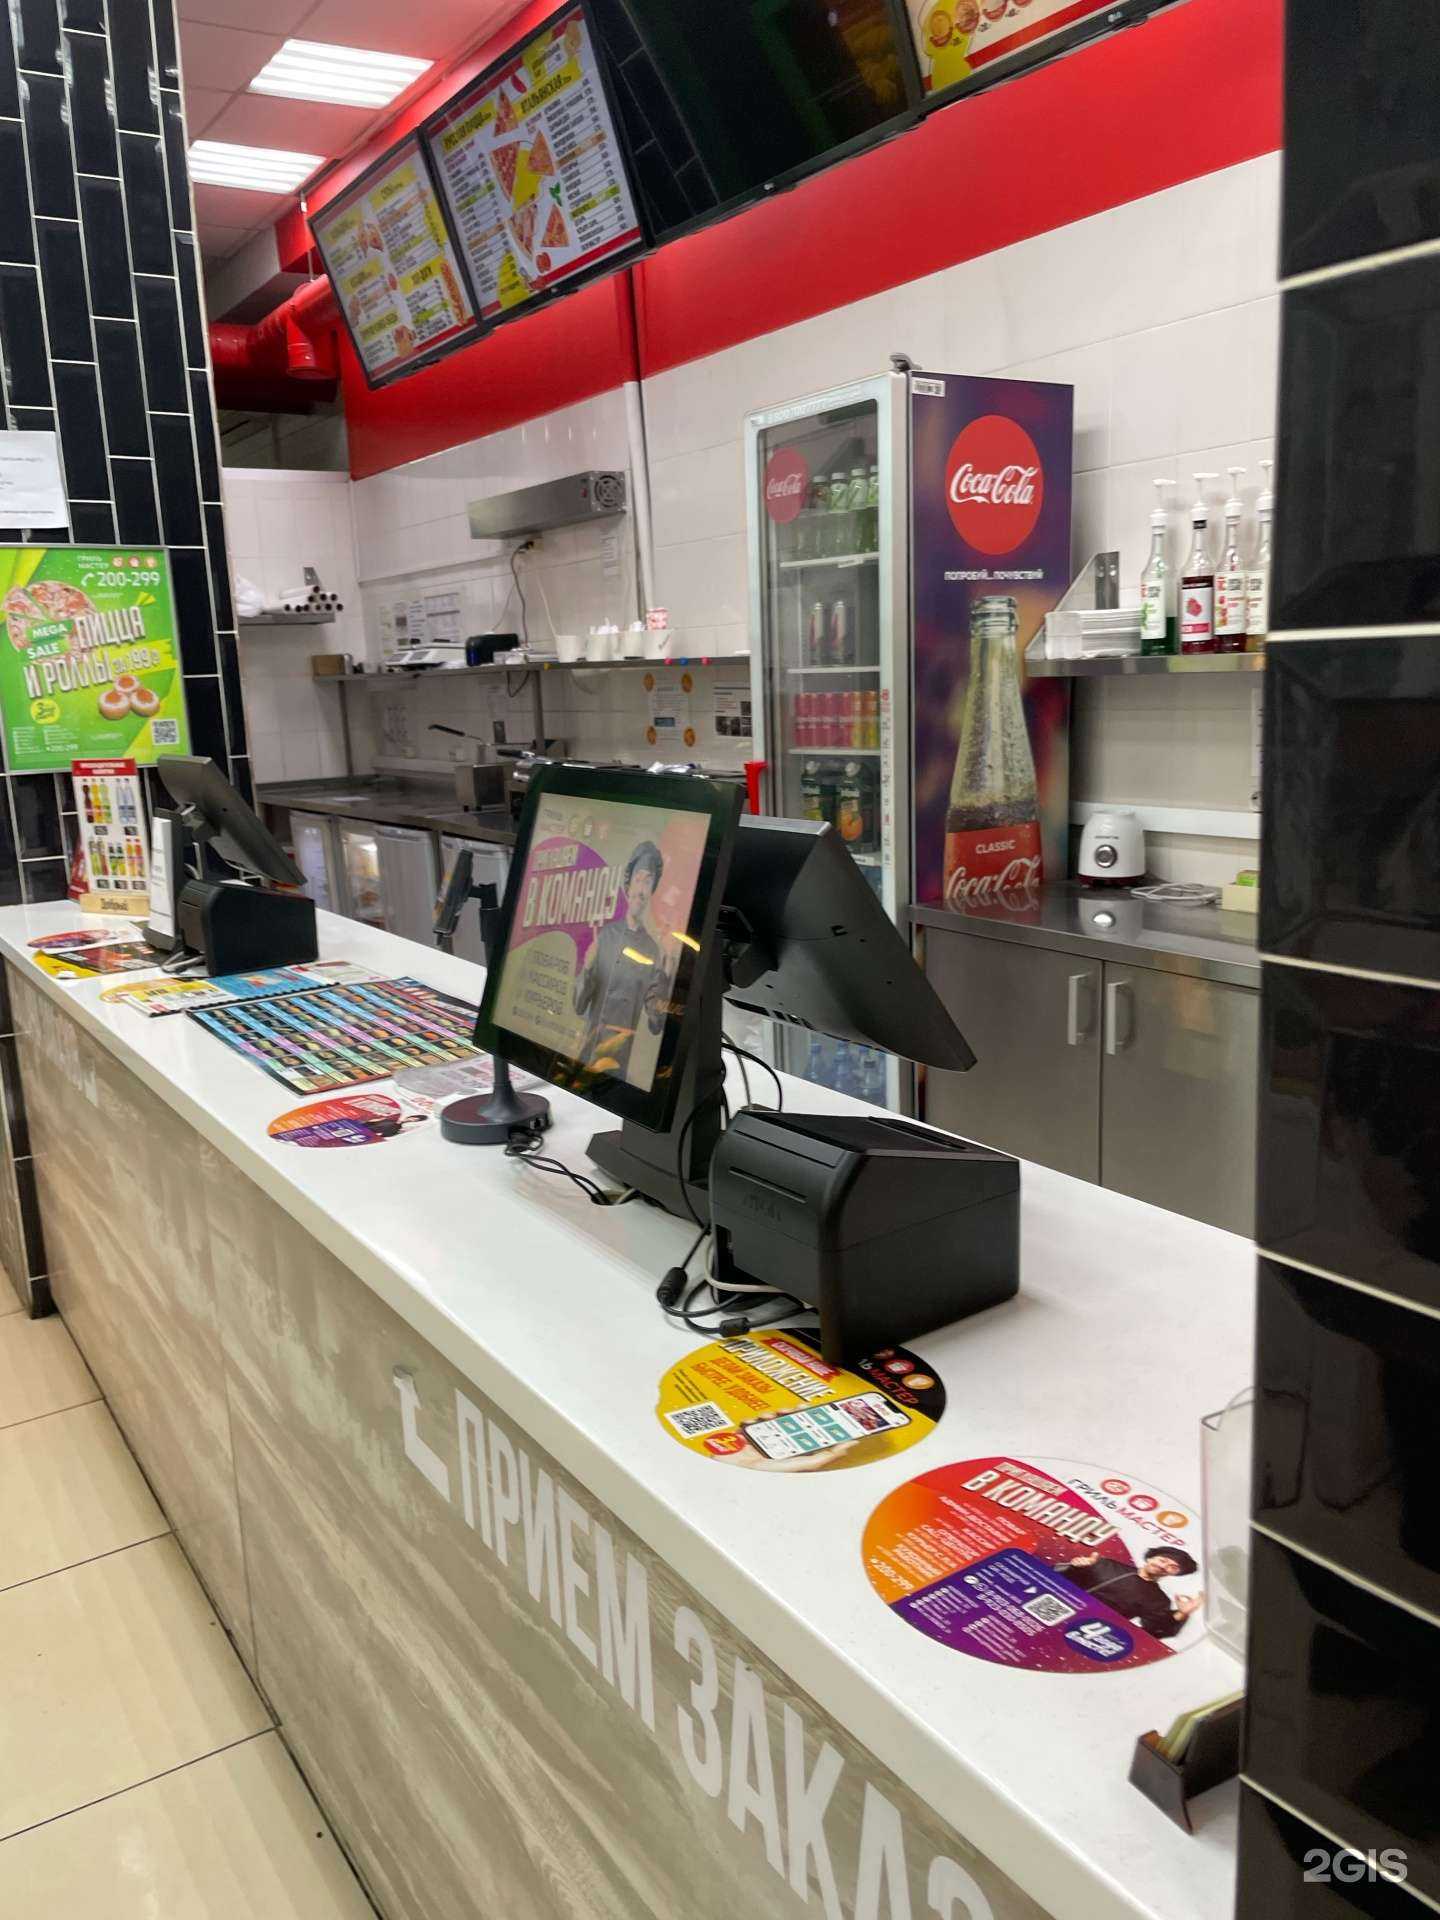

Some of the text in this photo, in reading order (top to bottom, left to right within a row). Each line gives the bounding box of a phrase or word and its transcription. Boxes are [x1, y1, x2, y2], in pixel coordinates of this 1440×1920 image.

[766, 473, 802, 499] Coca-Cola
[950, 463, 1039, 505] Coca-Cola
[96, 571, 161, 587] 200-299
[32, 624, 67, 639] MEGA
[75, 606, 146, 650] ПИЦЦА
[27, 643, 61, 659] SALE
[24, 665, 43, 698] И
[42, 648, 113, 694] РОЛЛЫ
[975, 839, 1017, 854] CLASSIC
[523, 865, 624, 928] В КОМАНДУ
[718, 1337, 837, 1400] ПРИЛОЖЕНИЕ
[960, 1469, 1122, 1549] В КОМАНДУ
[455, 1388, 656, 1731] ПРИЕМ
